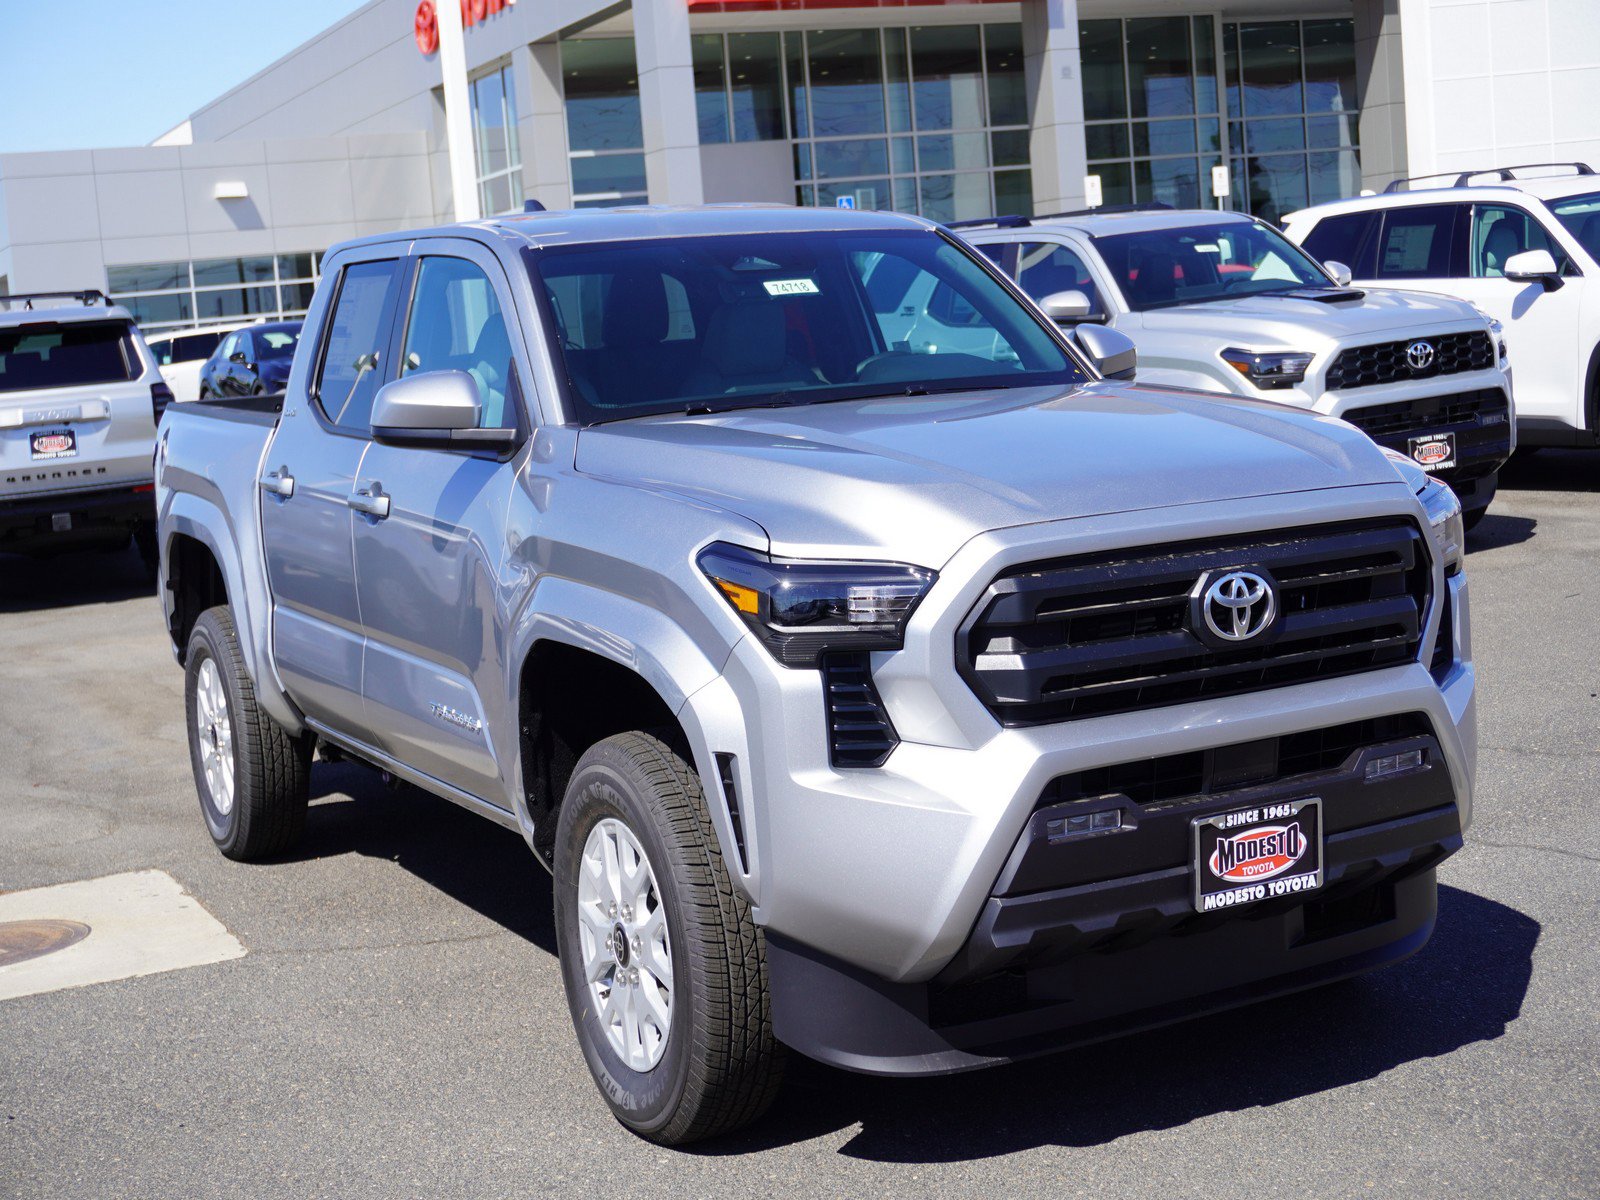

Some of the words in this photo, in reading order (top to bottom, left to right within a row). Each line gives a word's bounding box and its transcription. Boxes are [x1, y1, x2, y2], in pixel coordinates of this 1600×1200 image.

[1226, 810, 1259, 827] SINCE
[1263, 804, 1290, 820] 1965
[1217, 822, 1300, 877] MODESTO
[1242, 861, 1275, 877] TOYOTA
[1204, 885, 1265, 910] MODESTO
[1268, 874, 1317, 896] TOYOTA
